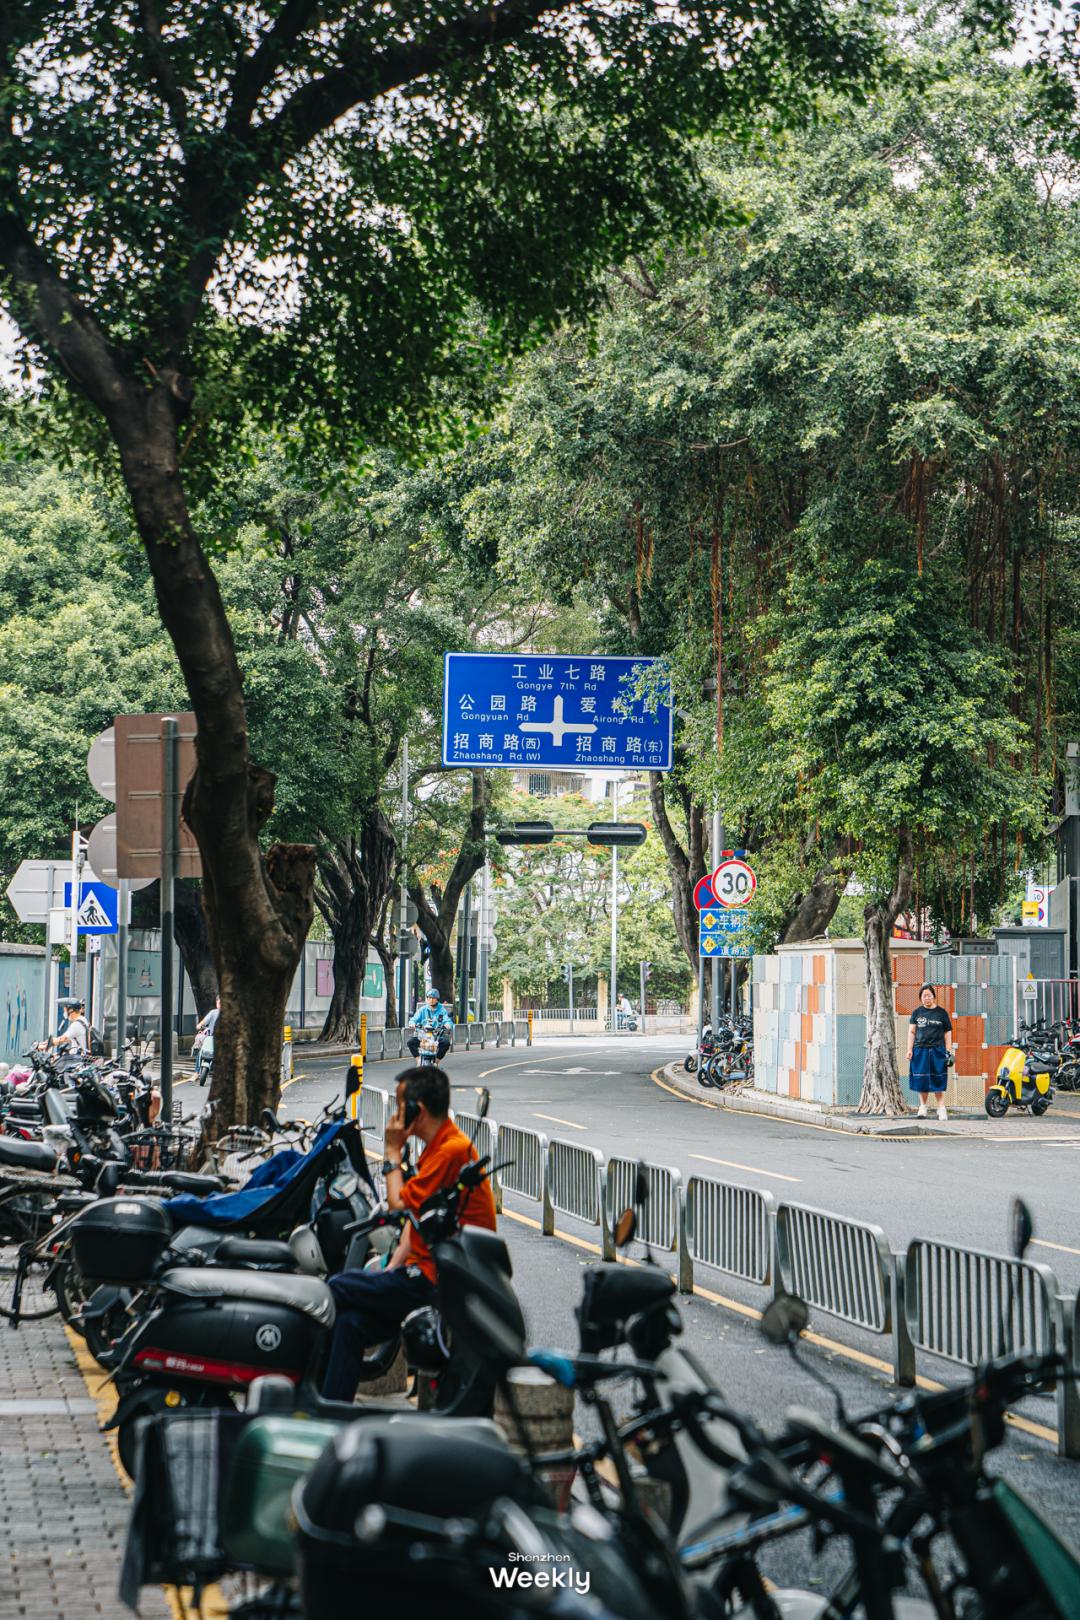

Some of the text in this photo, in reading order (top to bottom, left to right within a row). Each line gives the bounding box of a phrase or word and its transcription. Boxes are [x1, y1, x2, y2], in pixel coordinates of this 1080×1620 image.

[511, 663, 606, 681] 工业七路
[516, 681, 553, 691] Gongye
[458, 694, 537, 712] 公园路
[461, 711, 509, 722] Gongyuan
[593, 714, 624, 725] Airong
[453, 732, 541, 751] 招商路(西)
[576, 735, 664, 753] 招商路(东)
[453, 751, 503, 762] Zhaoshang
[526, 752, 541, 761] (W)
[575, 753, 625, 764] Zhaoshang
[649, 755, 662, 764] (E)
[721, 872, 748, 895] 30
